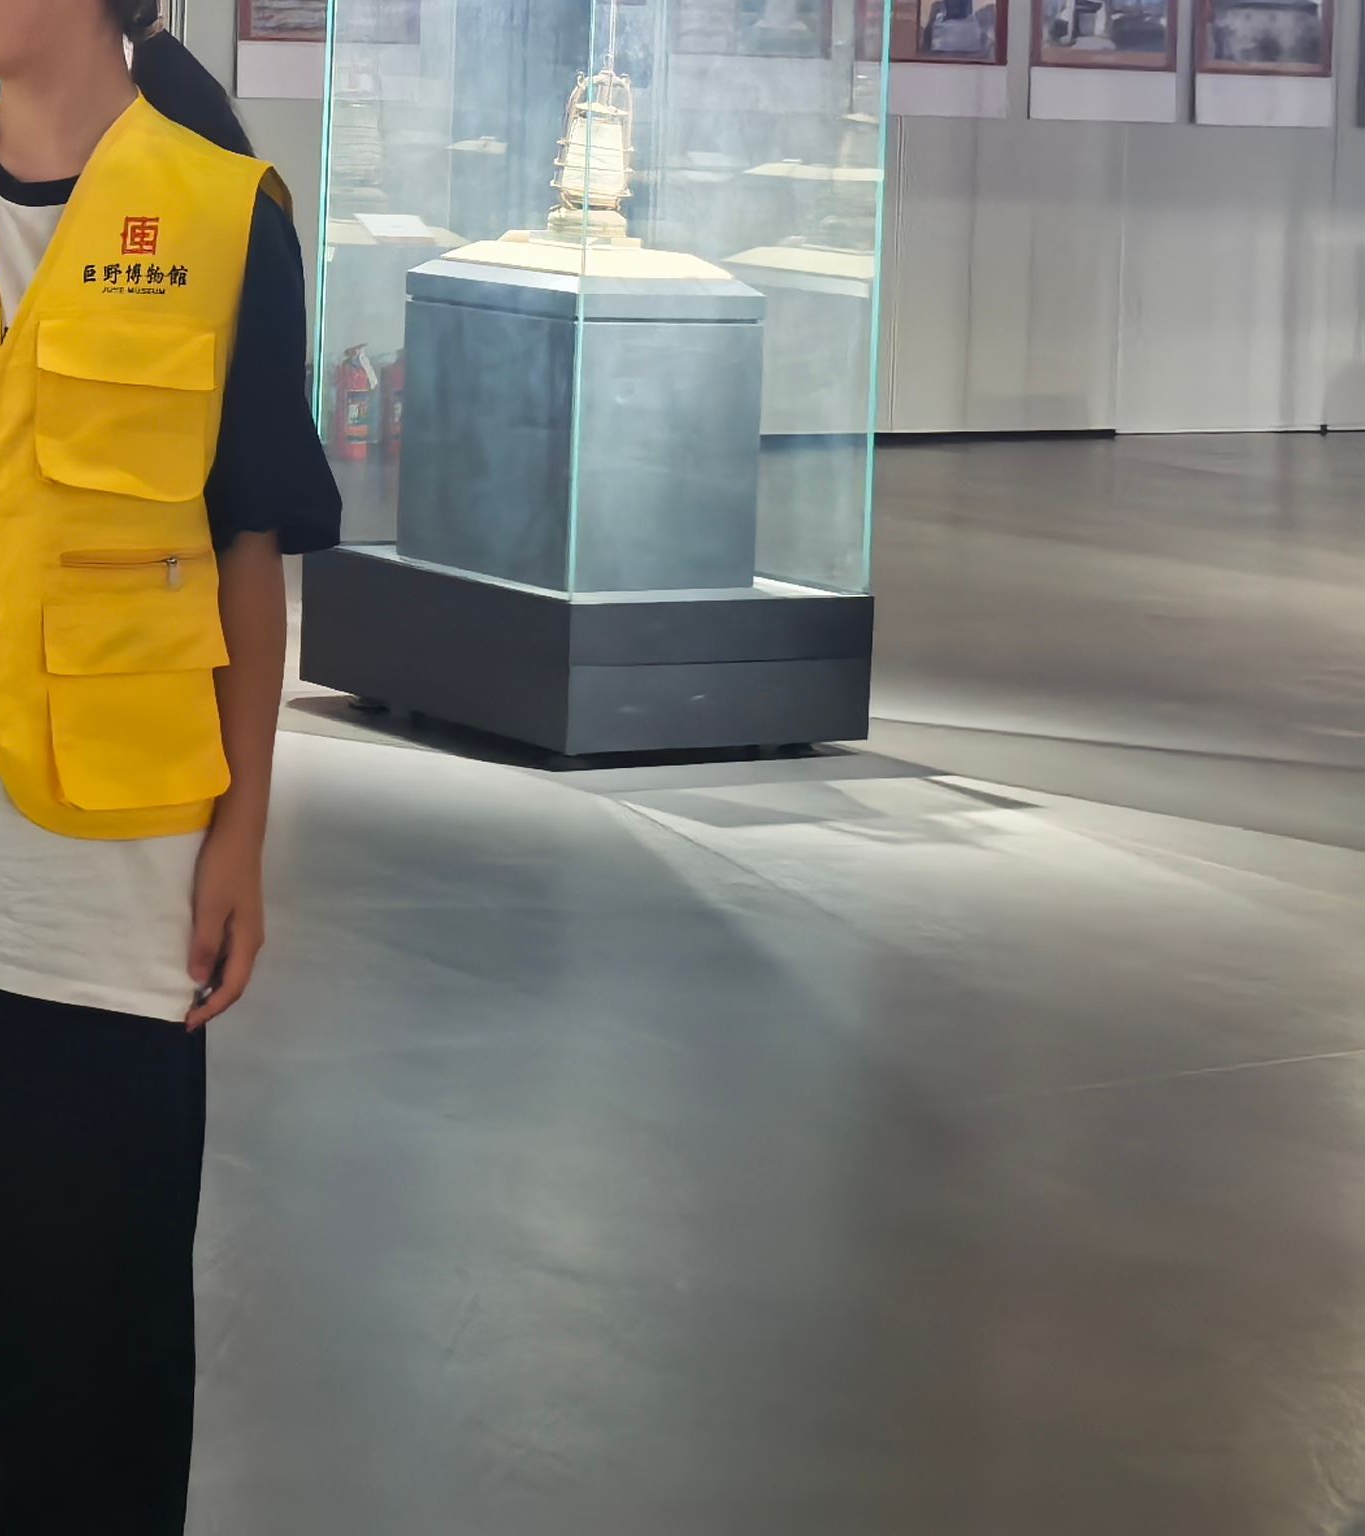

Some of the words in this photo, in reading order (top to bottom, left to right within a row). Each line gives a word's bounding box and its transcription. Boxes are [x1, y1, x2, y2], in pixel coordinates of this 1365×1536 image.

[83, 263, 189, 287] 巨野博物館
